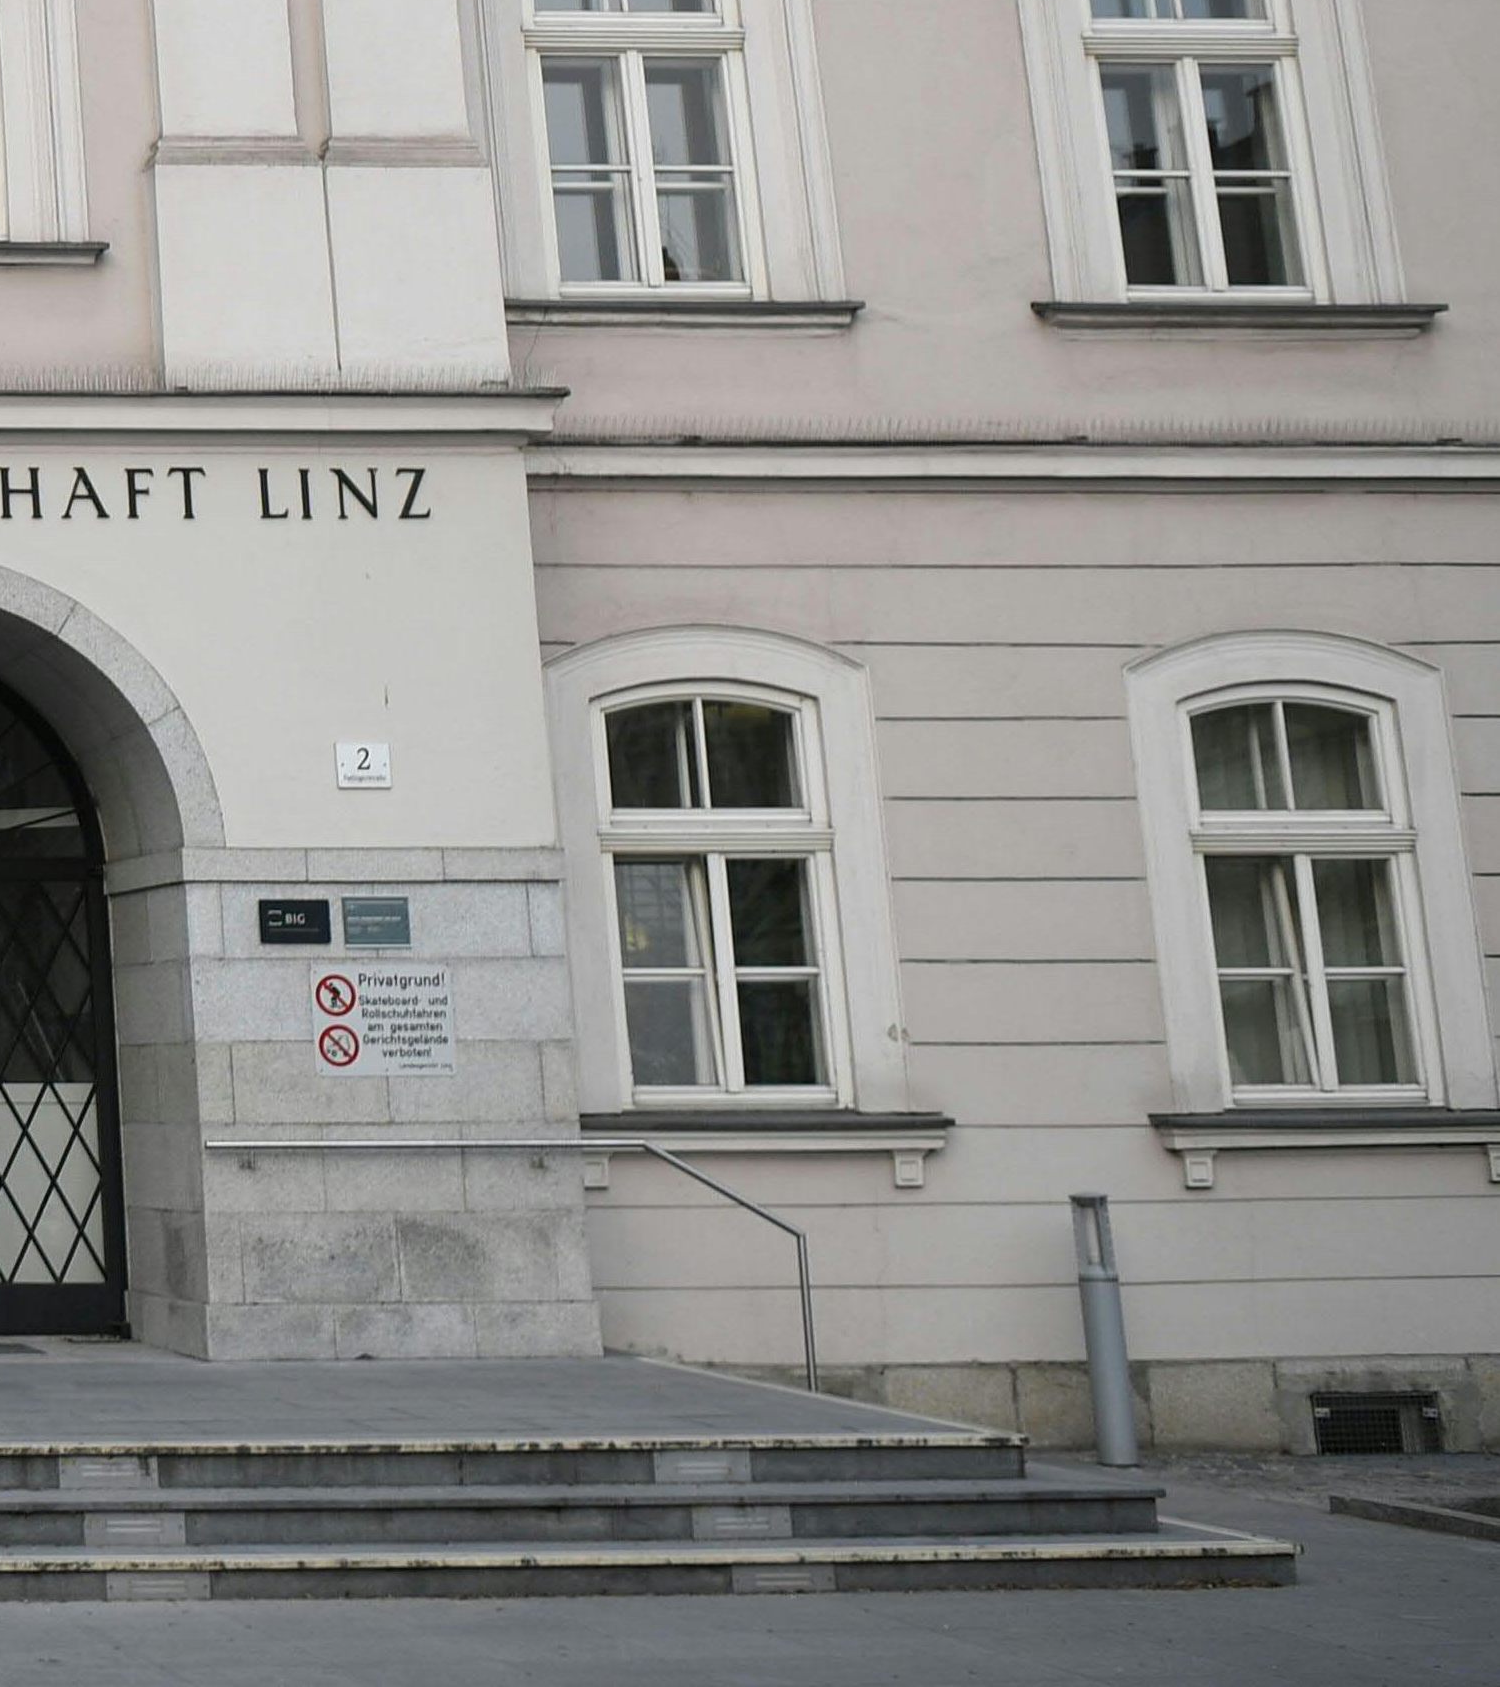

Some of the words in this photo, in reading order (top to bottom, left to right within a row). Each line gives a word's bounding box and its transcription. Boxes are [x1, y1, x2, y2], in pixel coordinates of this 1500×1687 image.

[257, 468, 432, 520] LINZ
[357, 747, 371, 770] 2
[285, 913, 306, 925] BIG
[358, 973, 445, 989] Privatgrund!
[428, 995, 448, 1006] und
[362, 1008, 447, 1019] Rollschuhfahren
[367, 1022, 384, 1032] am
[390, 1021, 443, 1033] gesamten
[362, 1034, 449, 1046] Gerichtsgelände
[382, 1047, 432, 1058] verboten!
